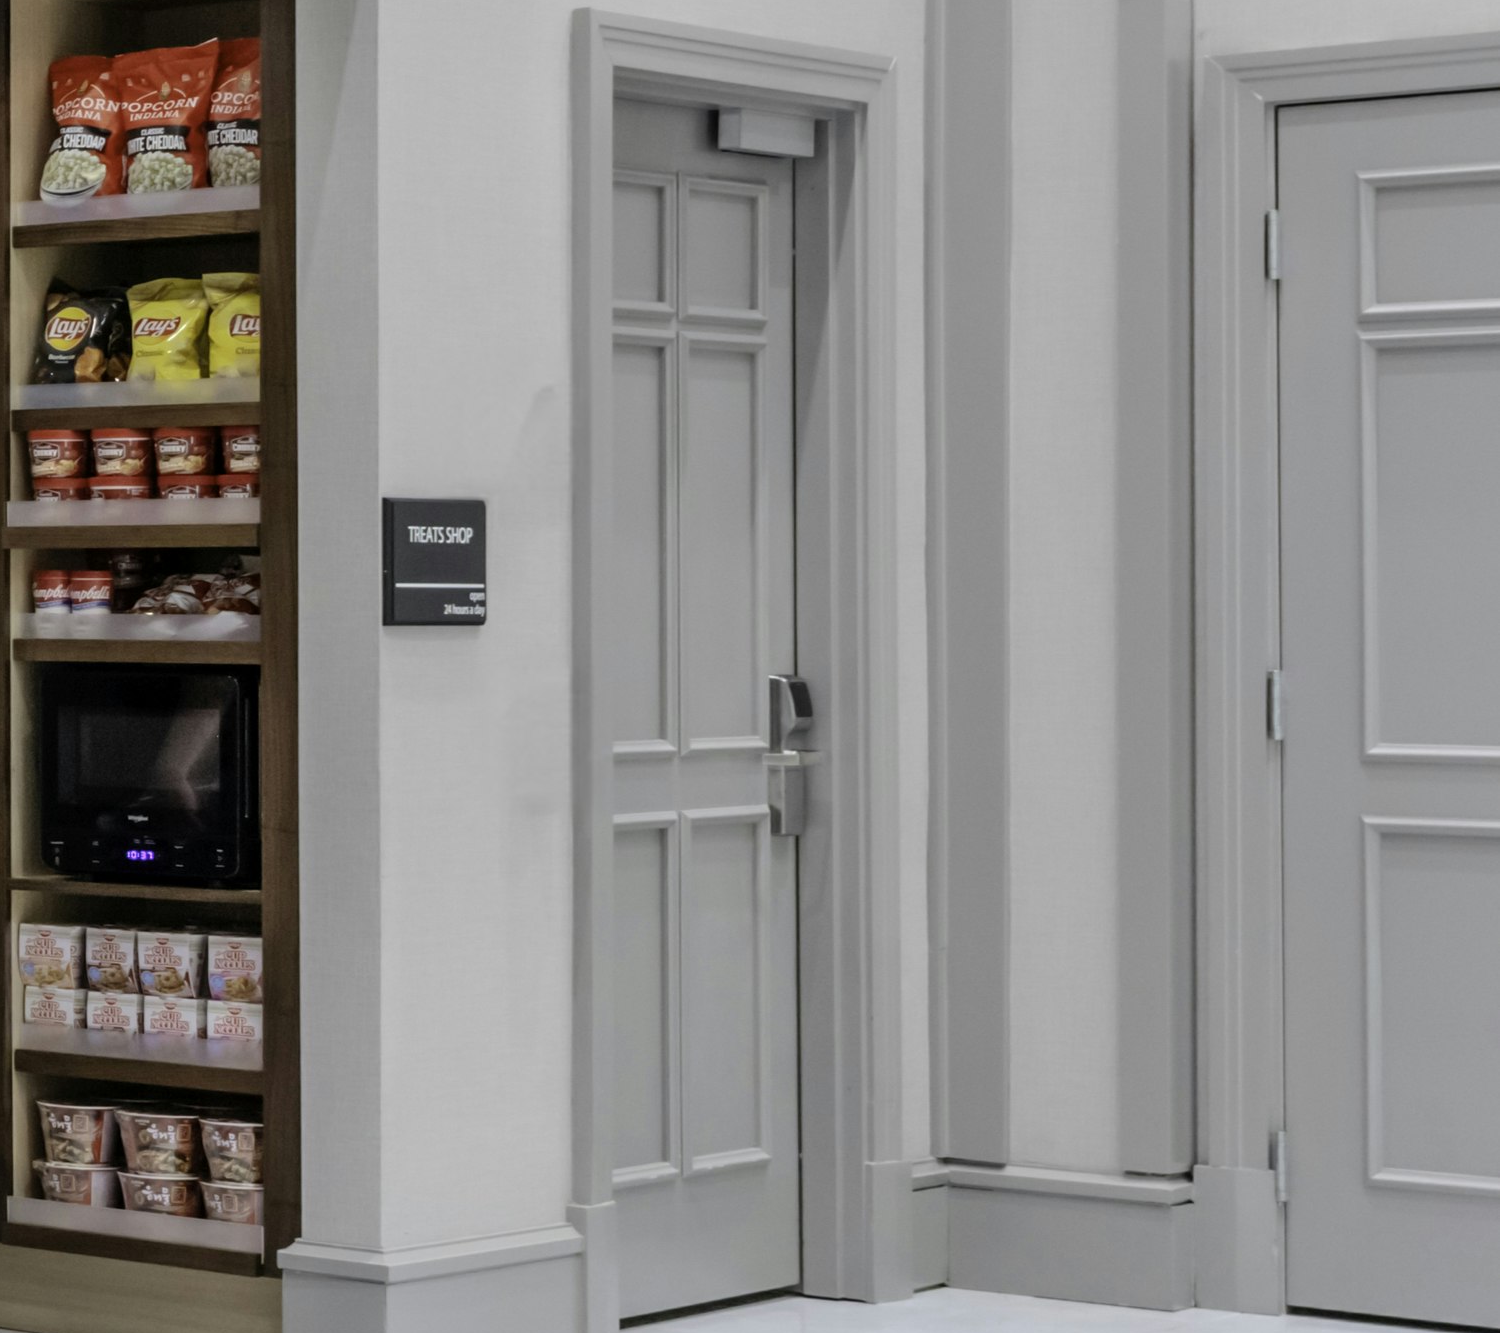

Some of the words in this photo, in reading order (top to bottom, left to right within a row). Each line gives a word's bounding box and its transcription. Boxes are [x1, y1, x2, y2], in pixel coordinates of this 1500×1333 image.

[52, 97, 121, 115] OPCORN
[130, 111, 179, 122] INDIANA
[220, 129, 258, 144] CHEDDAR
[63, 135, 106, 151] CHEDDAR
[147, 135, 187, 151] CHEDDAR
[408, 526, 444, 543] TREATS
[446, 527, 473, 544] SHOP
[469, 592, 485, 602] open
[474, 604, 485, 616] day
[126, 851, 154, 860] 10:37
[34, 938, 56, 947] CUP
[100, 942, 120, 952] CUP
[152, 946, 174, 956] CUP
[226, 951, 247, 961] CUP
[38, 1002, 59, 1011] CUP
[101, 1007, 122, 1017] CUP
[160, 1011, 181, 1021] CUP
[224, 1017, 246, 1026] CUP
